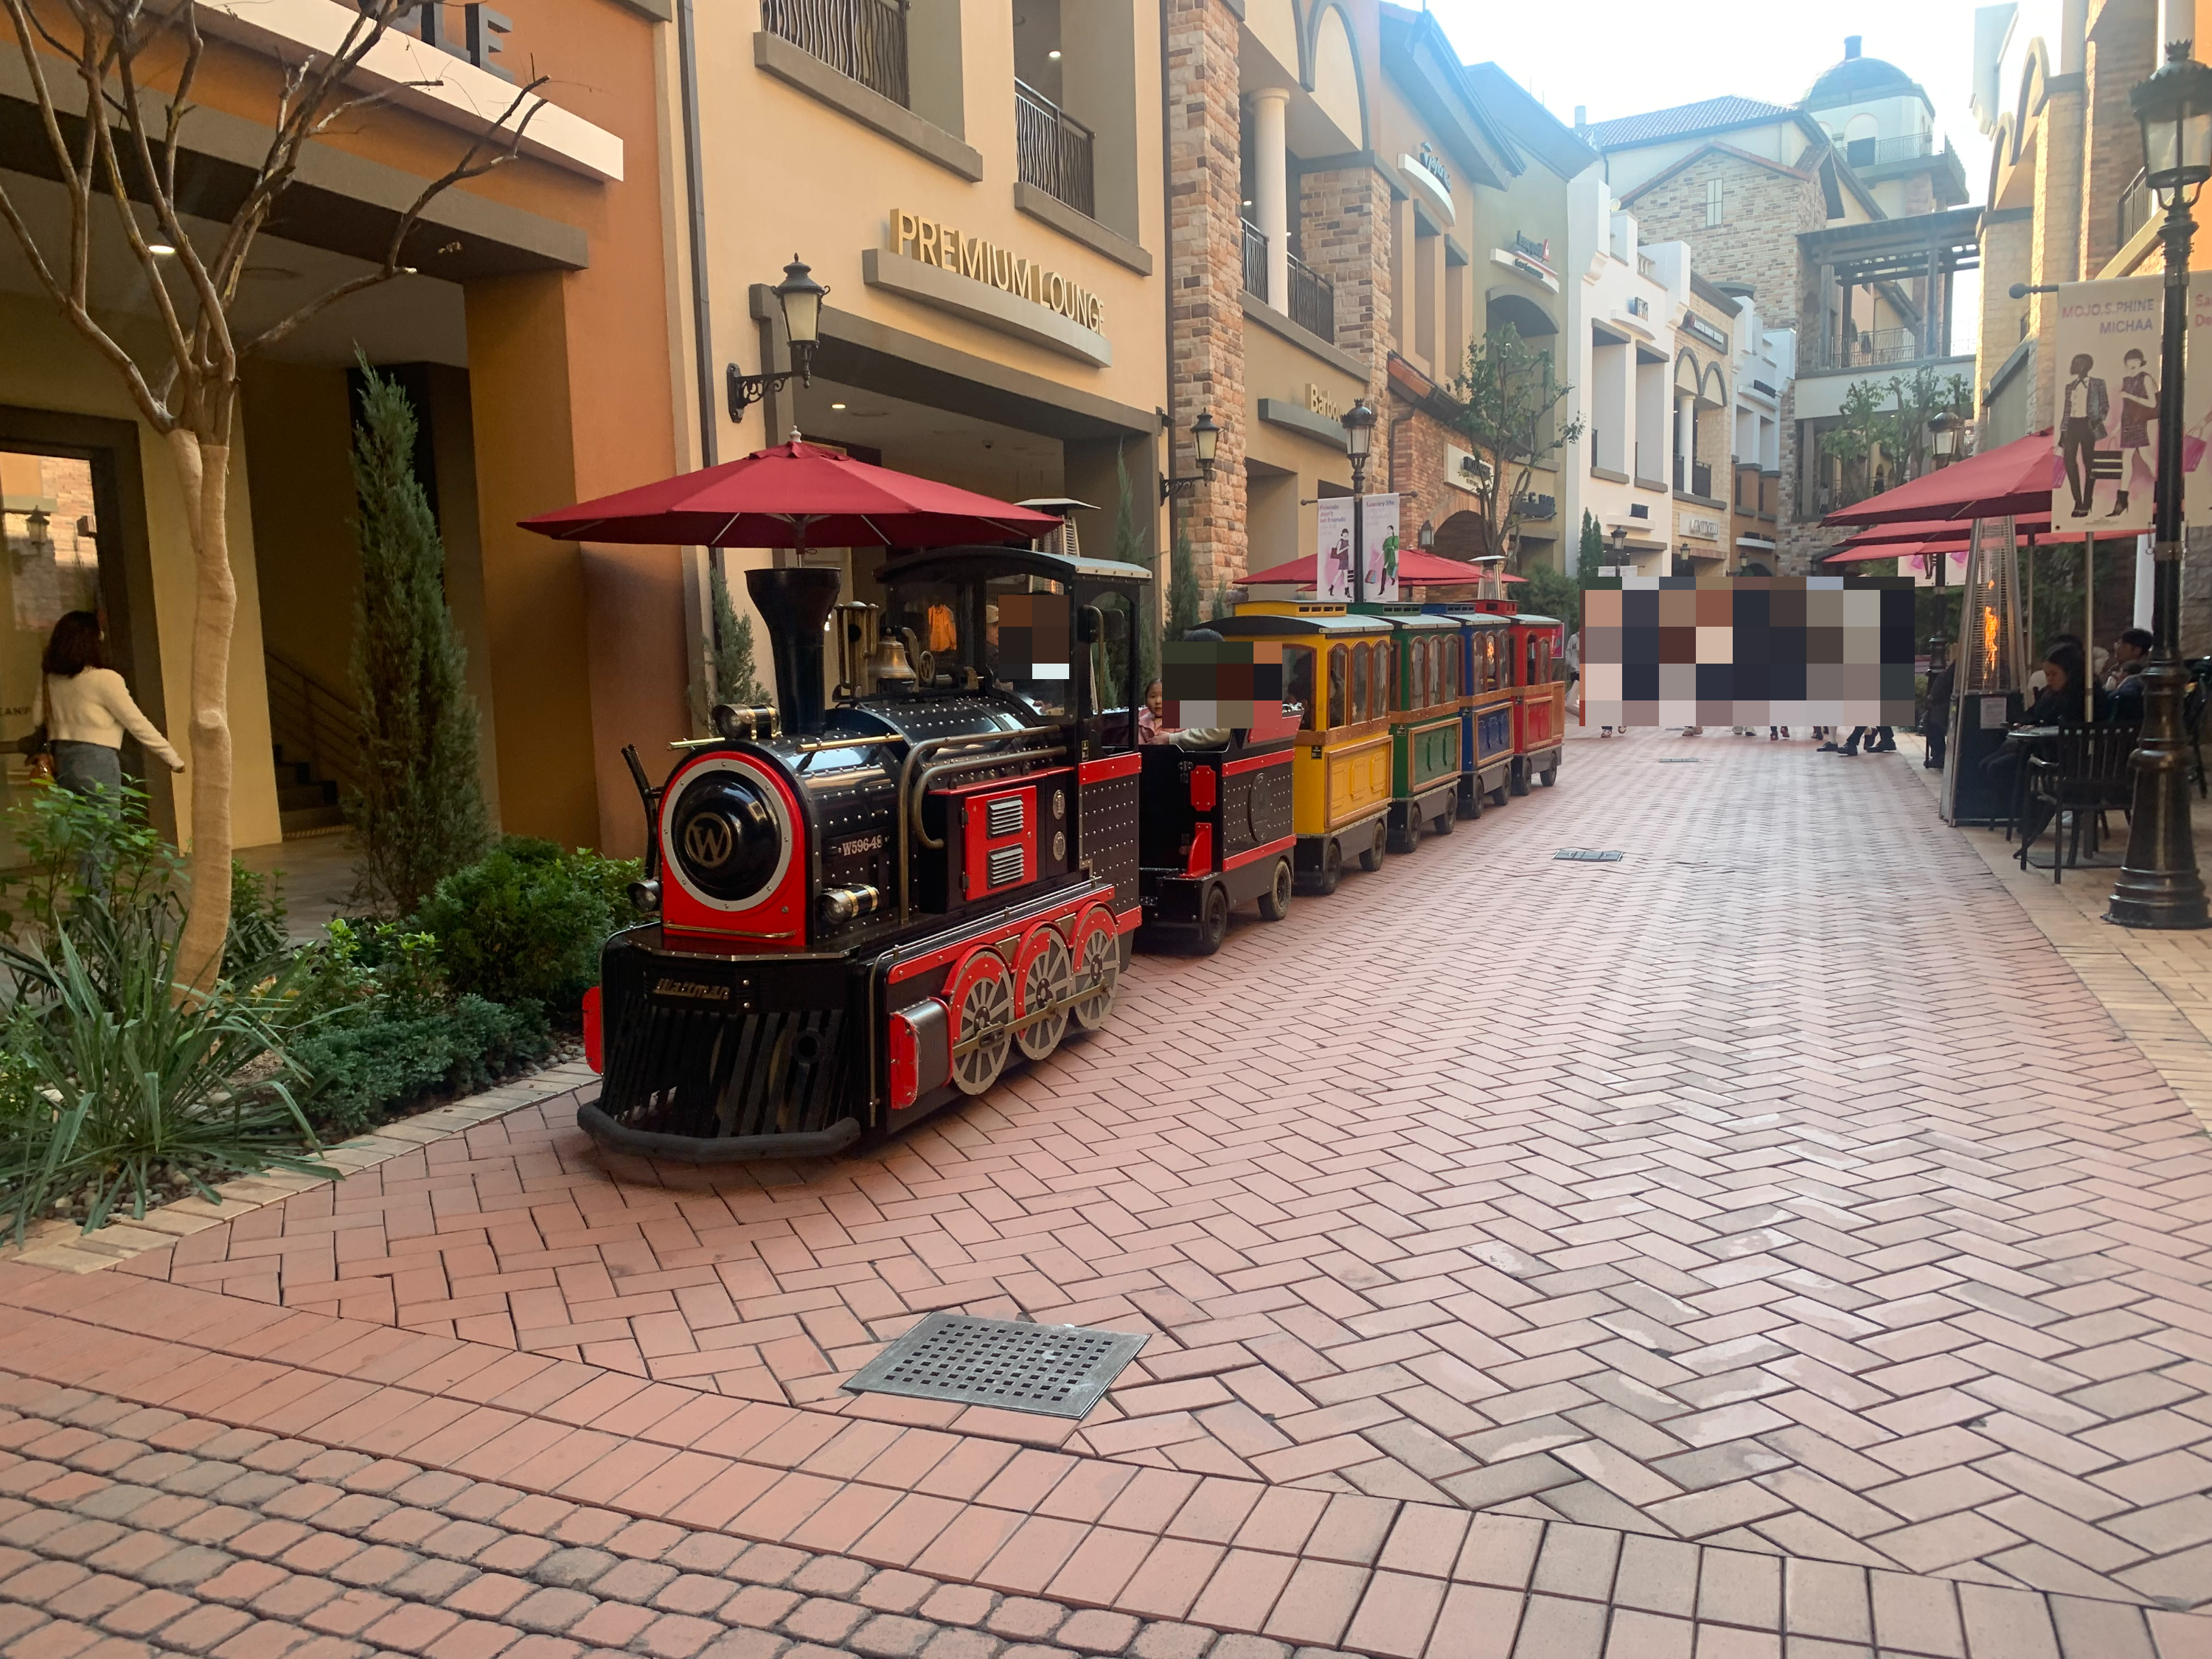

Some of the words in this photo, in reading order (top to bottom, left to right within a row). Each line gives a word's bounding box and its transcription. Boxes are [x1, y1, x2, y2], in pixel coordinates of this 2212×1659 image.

[890, 208, 1032, 301] PREMIUM
[1035, 265, 1106, 338] LOUNGE
[2062, 298, 2154, 319] MOJO.S.PHINE
[2196, 293, 2212, 307] Sa
[2099, 318, 2153, 335] MICHAA
[1305, 383, 1343, 423] Barbou
[687, 817, 731, 865] W
